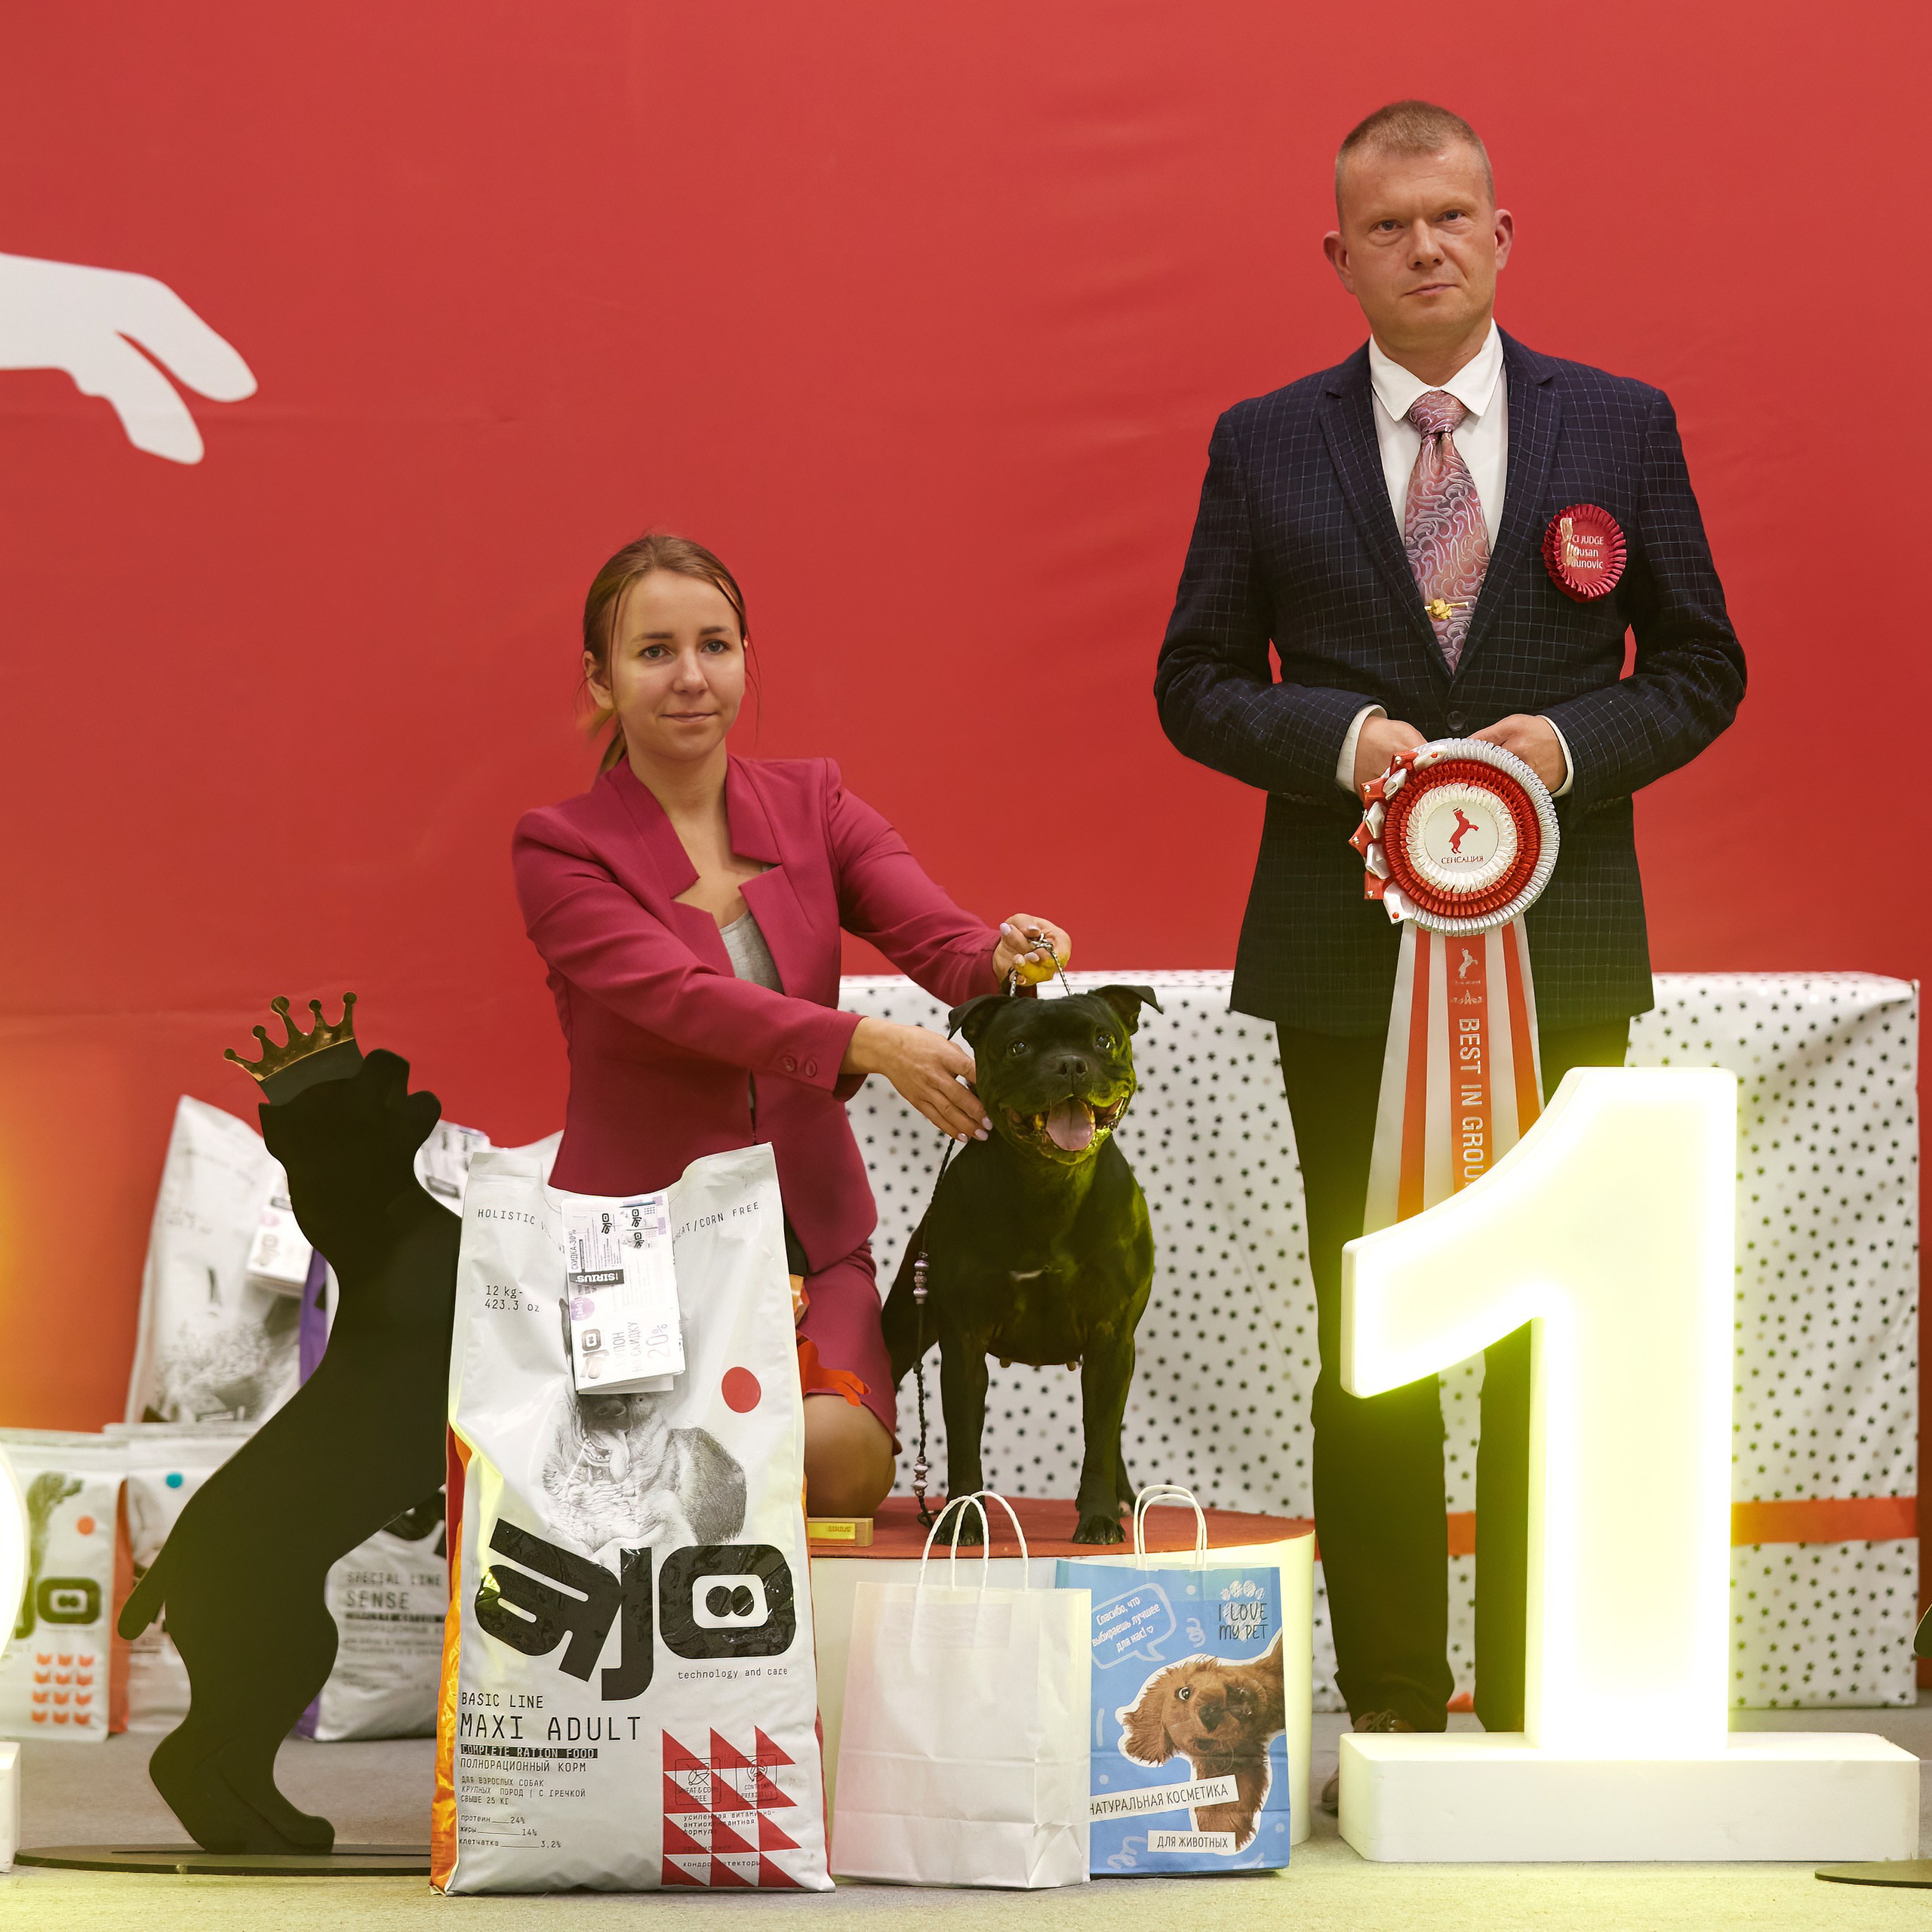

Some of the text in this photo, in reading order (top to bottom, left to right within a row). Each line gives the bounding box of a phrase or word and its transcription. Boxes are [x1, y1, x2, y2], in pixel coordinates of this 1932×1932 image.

[1581, 535, 1604, 545] JUDGE
[1441, 855, 1484, 864] СЕНСАЦИЯ
[1459, 1018, 1481, 1075] BEST
[1460, 1084, 1483, 1106] IN
[1461, 1115, 1485, 1186] GROU
[477, 1208, 536, 1225] HOLISTIC
[732, 1201, 759, 1217] FREE
[577, 1272, 616, 1283] SIRIUS
[486, 1284, 499, 1296] 12
[485, 1298, 540, 1312] 423.3 oz
[346, 1589, 410, 1610] SENSE
[1096, 1596, 1141, 1626] Спасибо, что
[1131, 1603, 1161, 1626] лучшее
[1218, 1602, 1268, 1622] I LOVE
[1245, 1623, 1269, 1640] PET
[1116, 1626, 1148, 1654] для нас!
[678, 1667, 789, 1679] technology and care
[461, 1691, 544, 1709] BASIC LINE
[460, 1712, 641, 1741] MAXI ADULT
[461, 1743, 595, 1759] COMPLETE RATION FOOD
[460, 1758, 587, 1773] ПОЛНОРАЦИОННЫЙ КОРМ
[461, 1775, 545, 1787] ДЛЯ ВЗРОСЛЫХ СОБАК
[460, 1785, 586, 1798] КРУПНЫХ ПОРОД С ГРЕЧКОЙ
[1090, 1783, 1229, 1816] НАТУРАЛЬНАЯ КОСМЕТИКА
[460, 1795, 509, 1806] СВЫШЕ 25 КГ
[460, 1814, 491, 1824] протеин
[459, 1837, 500, 1847] клетчатка
[1156, 1835, 1229, 1848] ДЛЯ ЖИВОТНЫХ
